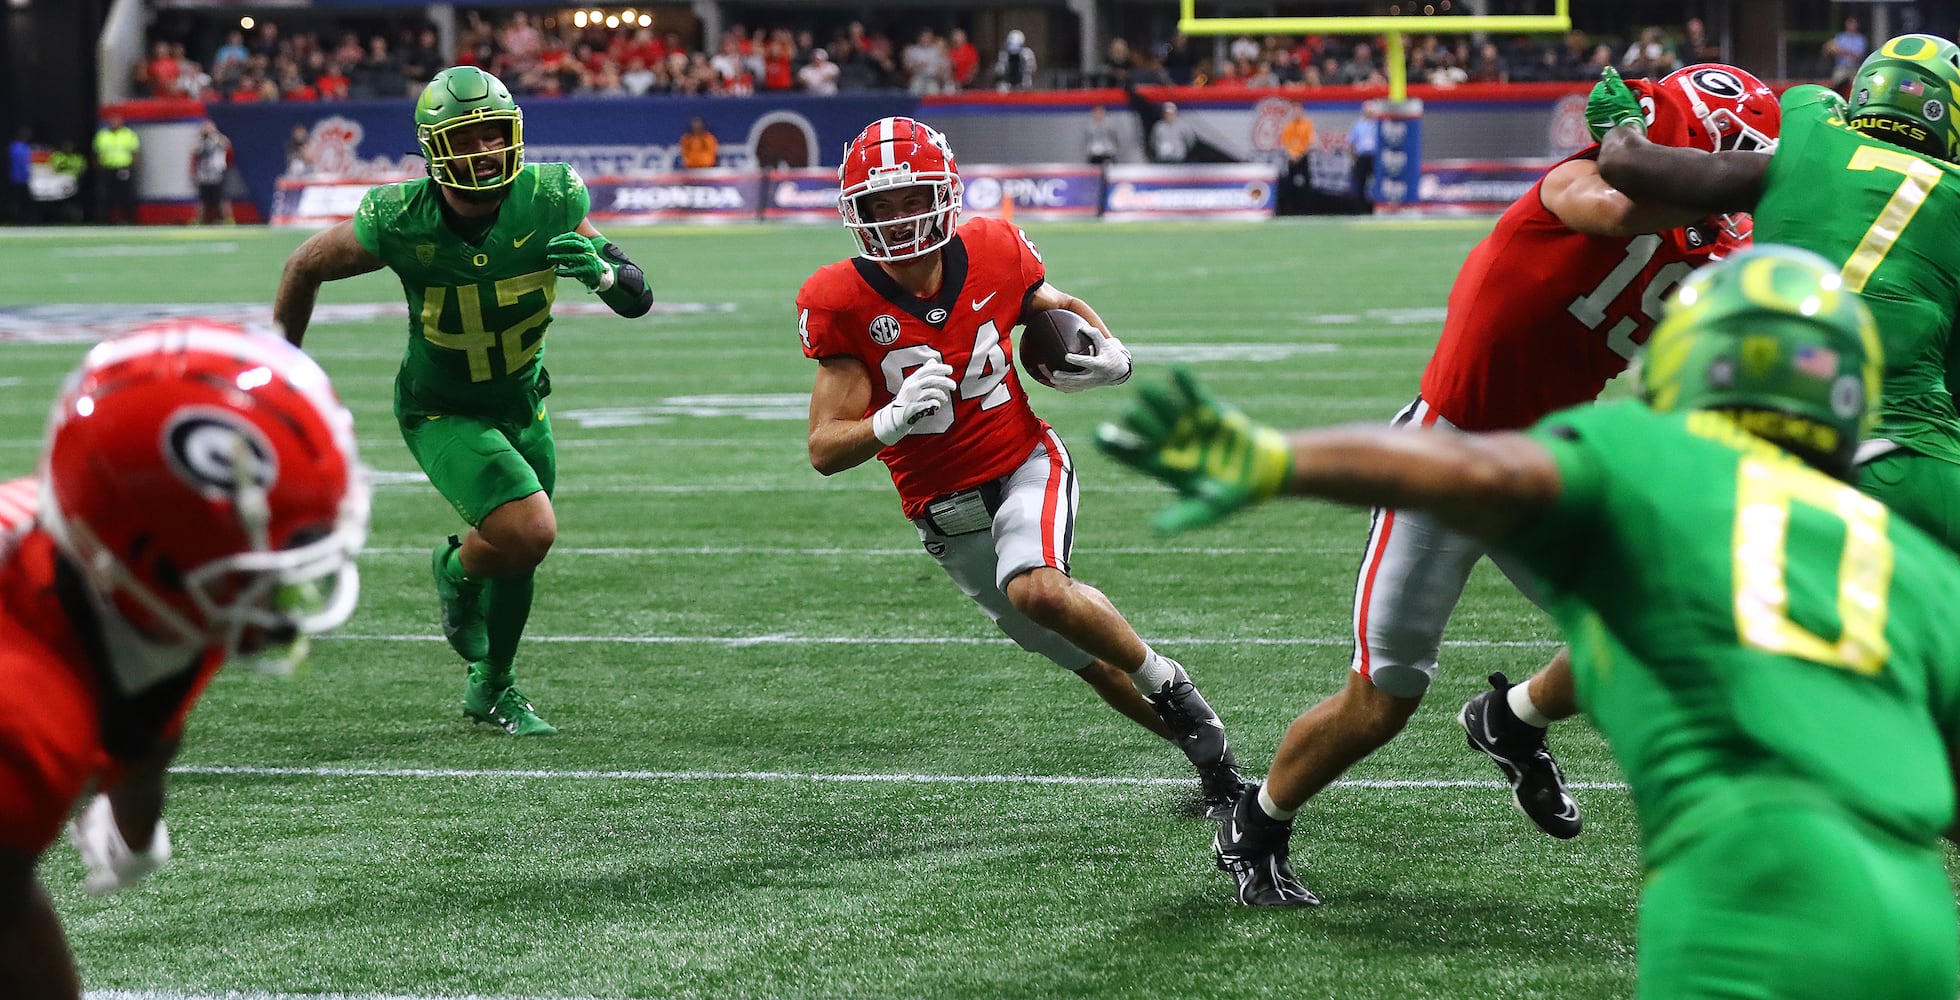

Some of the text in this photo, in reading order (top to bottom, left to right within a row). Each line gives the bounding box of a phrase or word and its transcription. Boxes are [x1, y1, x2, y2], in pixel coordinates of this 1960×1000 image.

[1848, 118, 1927, 141] DUCKS
[611, 186, 744, 209] HONDA
[1002, 179, 1067, 207] PNC
[1843, 144, 1944, 293] 7
[421, 267, 557, 383] 42
[798, 308, 811, 349] 4
[871, 317, 899, 342] SEC
[927, 309, 946, 323] G
[881, 319, 1012, 435] 84
[1732, 453, 1888, 676] 0
